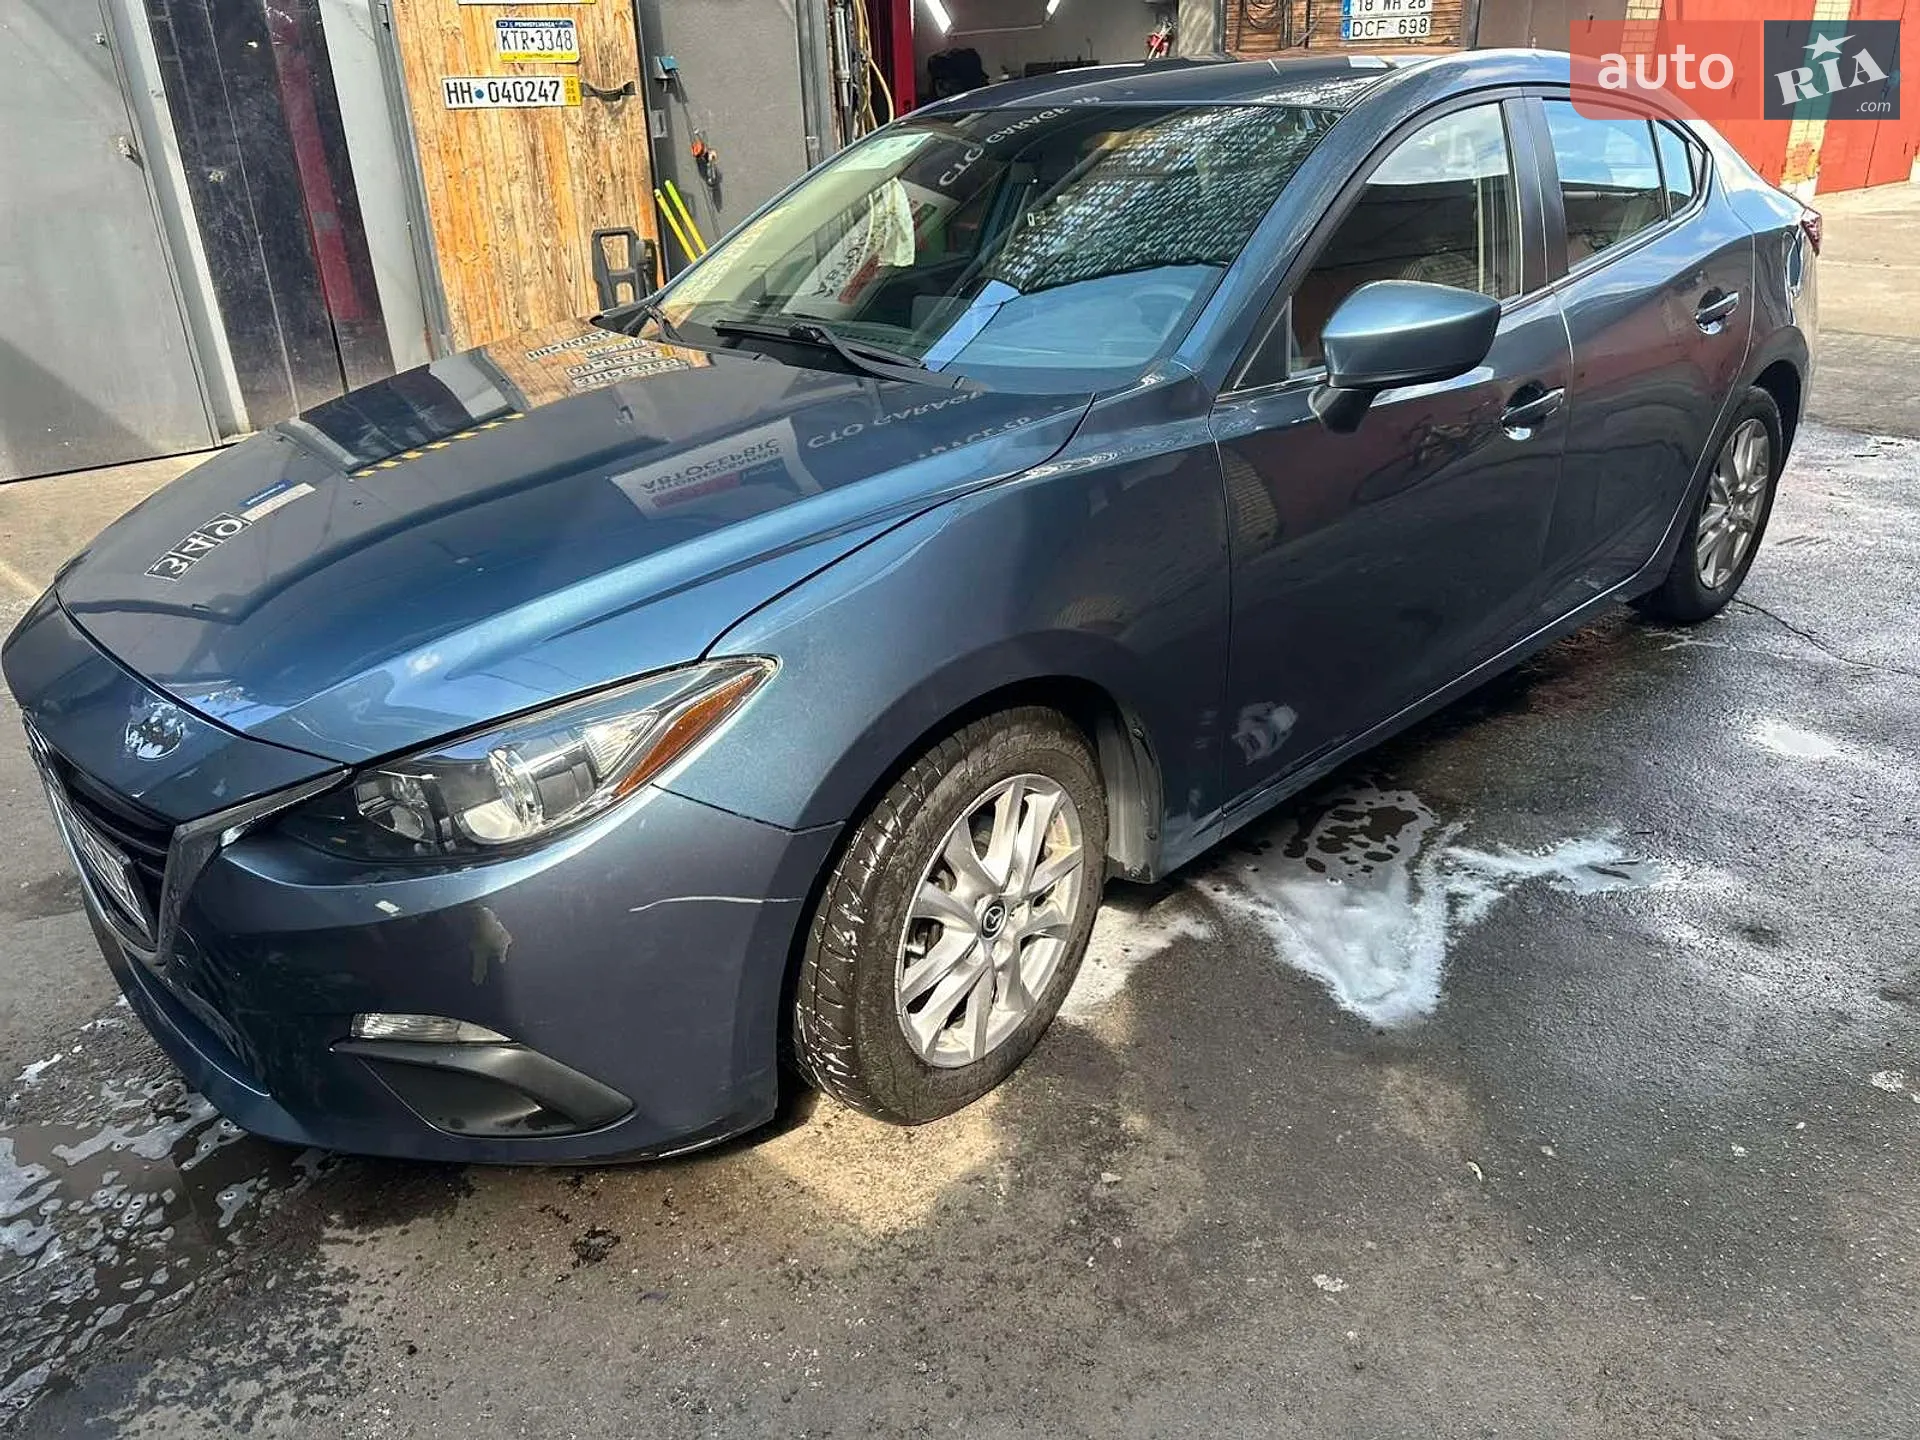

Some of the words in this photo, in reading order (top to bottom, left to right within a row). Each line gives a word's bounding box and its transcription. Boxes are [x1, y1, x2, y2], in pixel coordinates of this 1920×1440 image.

[1352, 20, 1387, 37] DCF
[1399, 18, 1428, 35] 698
[446, 82, 473, 104] HH
[488, 80, 560, 103] 040247
